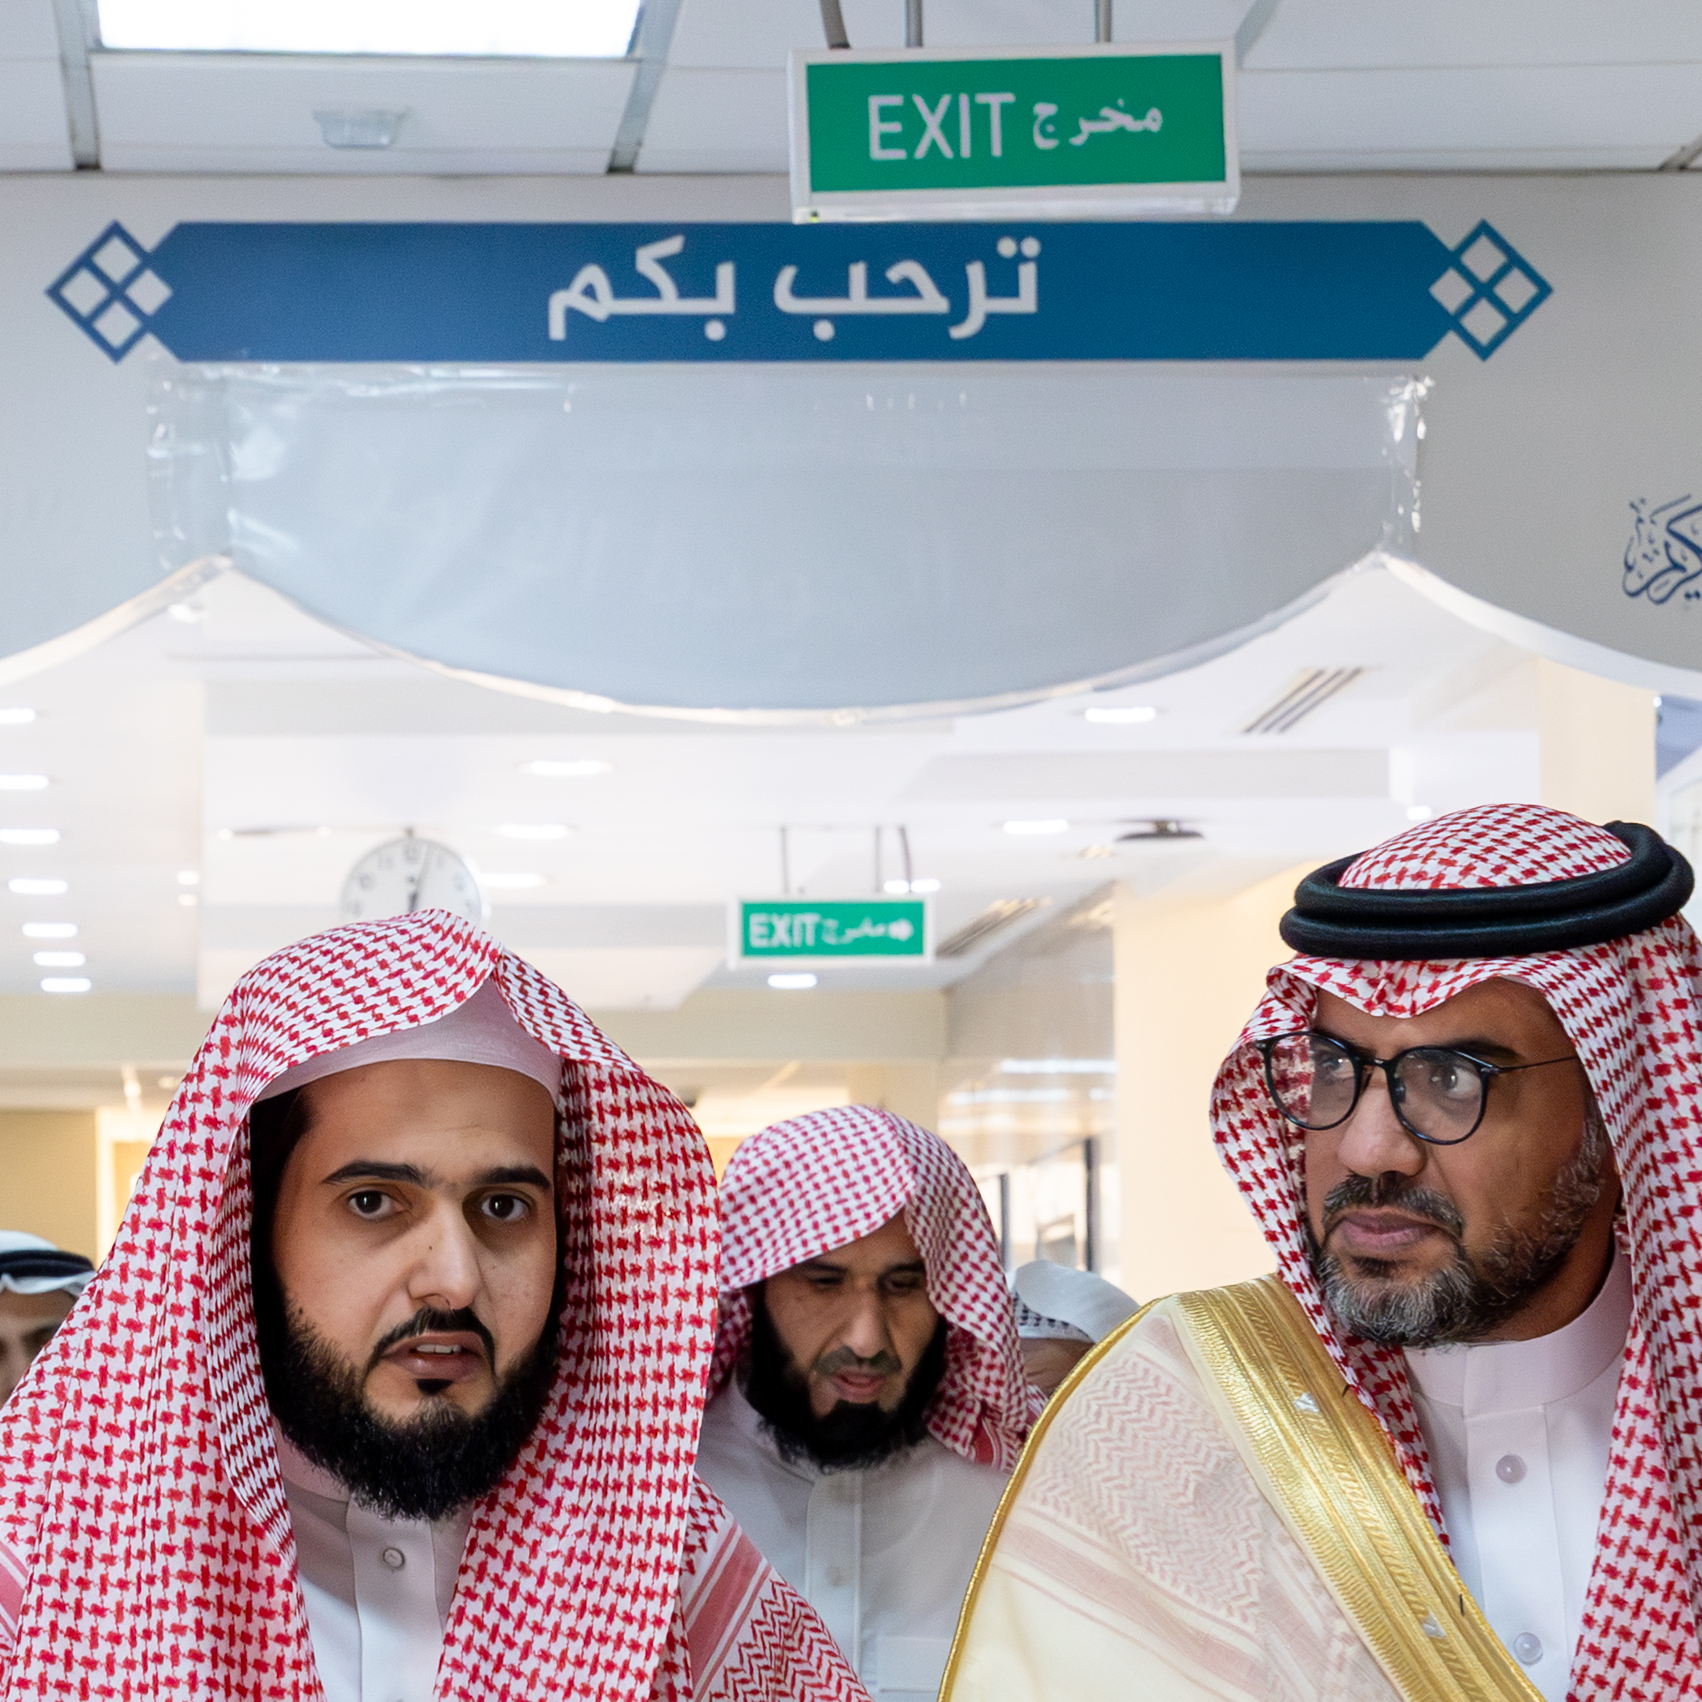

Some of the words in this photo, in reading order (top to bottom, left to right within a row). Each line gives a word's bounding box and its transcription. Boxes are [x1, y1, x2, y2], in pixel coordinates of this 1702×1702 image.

[868, 93, 1015, 161] EXIT
[1032, 100, 1164, 149] مخرج
[548, 234, 737, 342] بكم
[773, 236, 1041, 341] ترحب
[749, 912, 822, 949] EXIT
